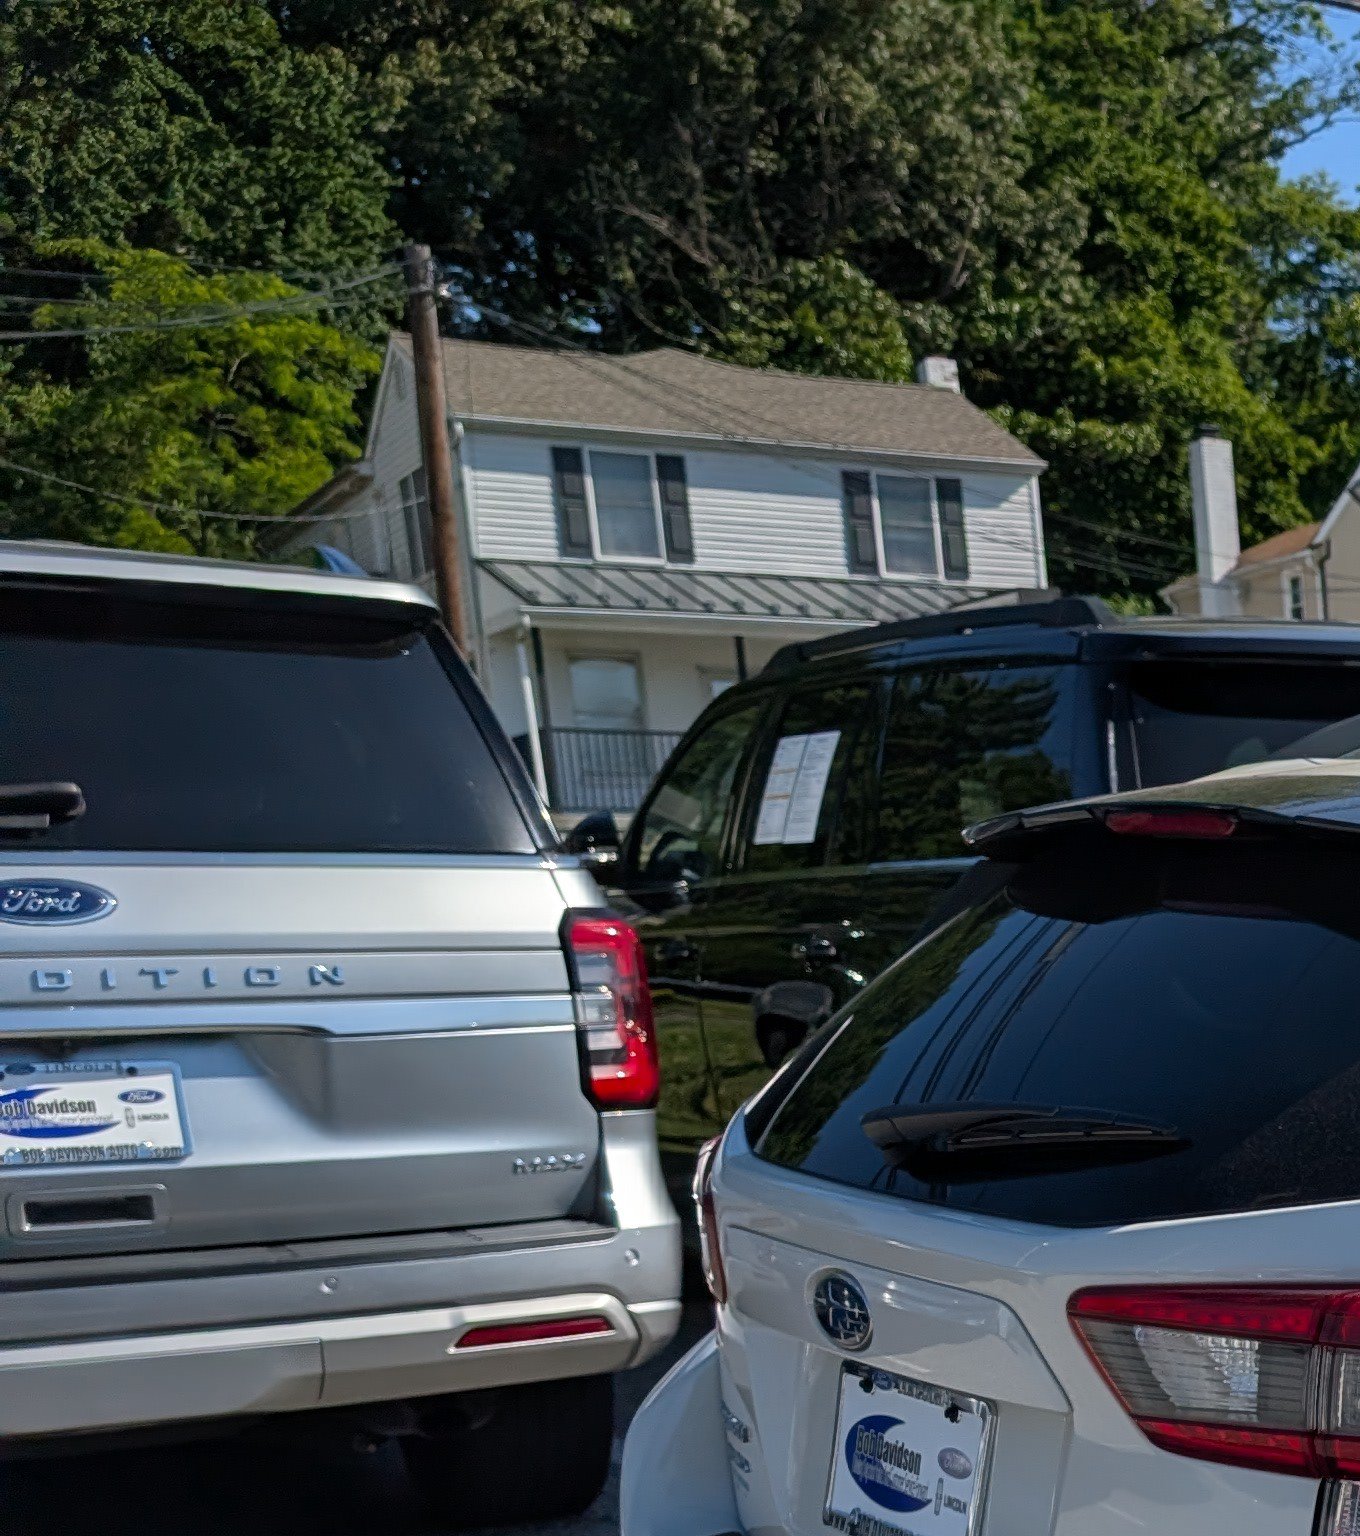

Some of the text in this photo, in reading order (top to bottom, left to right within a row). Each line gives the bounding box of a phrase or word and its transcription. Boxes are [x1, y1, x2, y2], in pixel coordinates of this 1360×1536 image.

[3, 887, 81, 913] Ford
[27, 1099, 97, 1116] Davidson
[511, 1153, 586, 1174] MAX
[856, 1425, 878, 1457] Bob
[876, 1432, 922, 1477] Davidson
